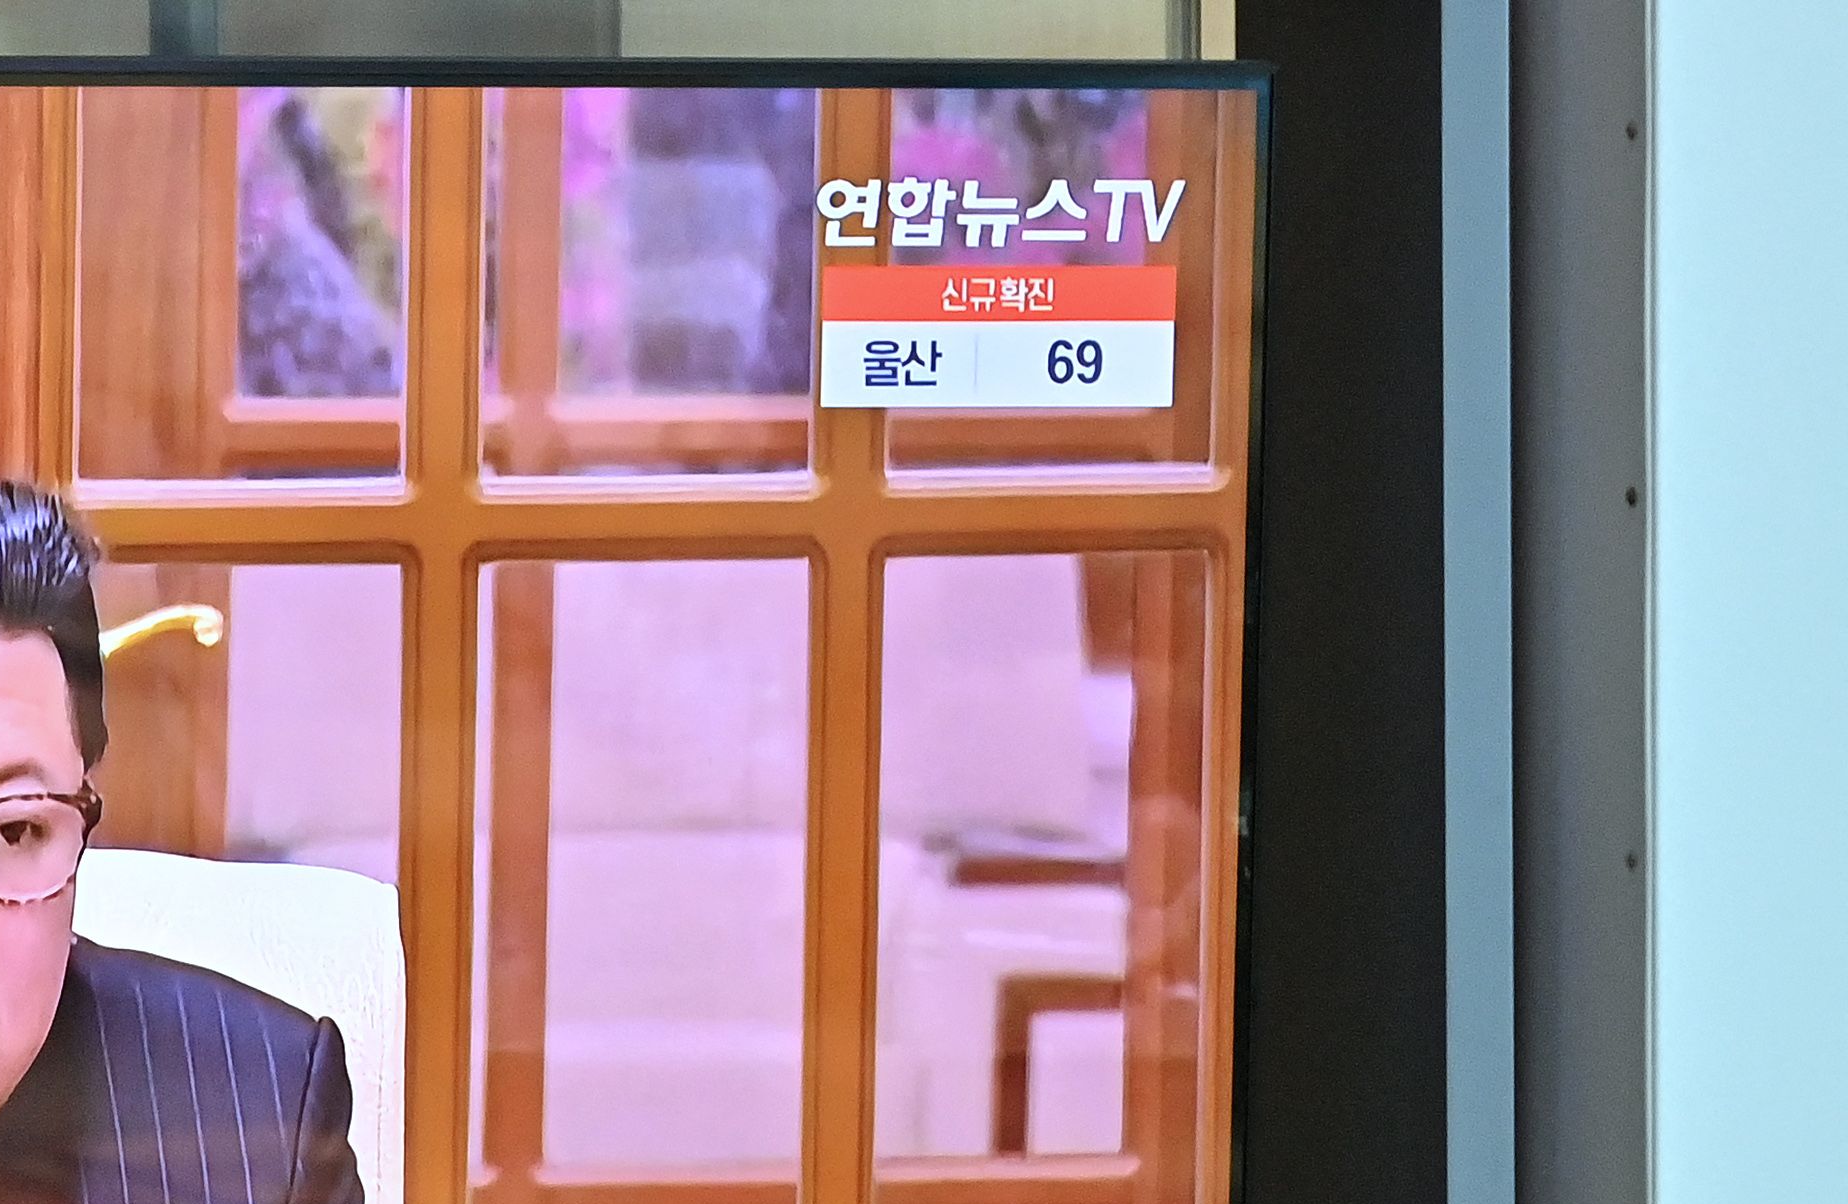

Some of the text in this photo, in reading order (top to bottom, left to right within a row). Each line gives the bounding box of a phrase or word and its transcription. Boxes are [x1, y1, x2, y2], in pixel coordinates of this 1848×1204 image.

[816, 176, 1186, 248] 연합뉴스TV
[941, 278, 1055, 312] 신규확진
[863, 340, 1103, 388] 울산 69
